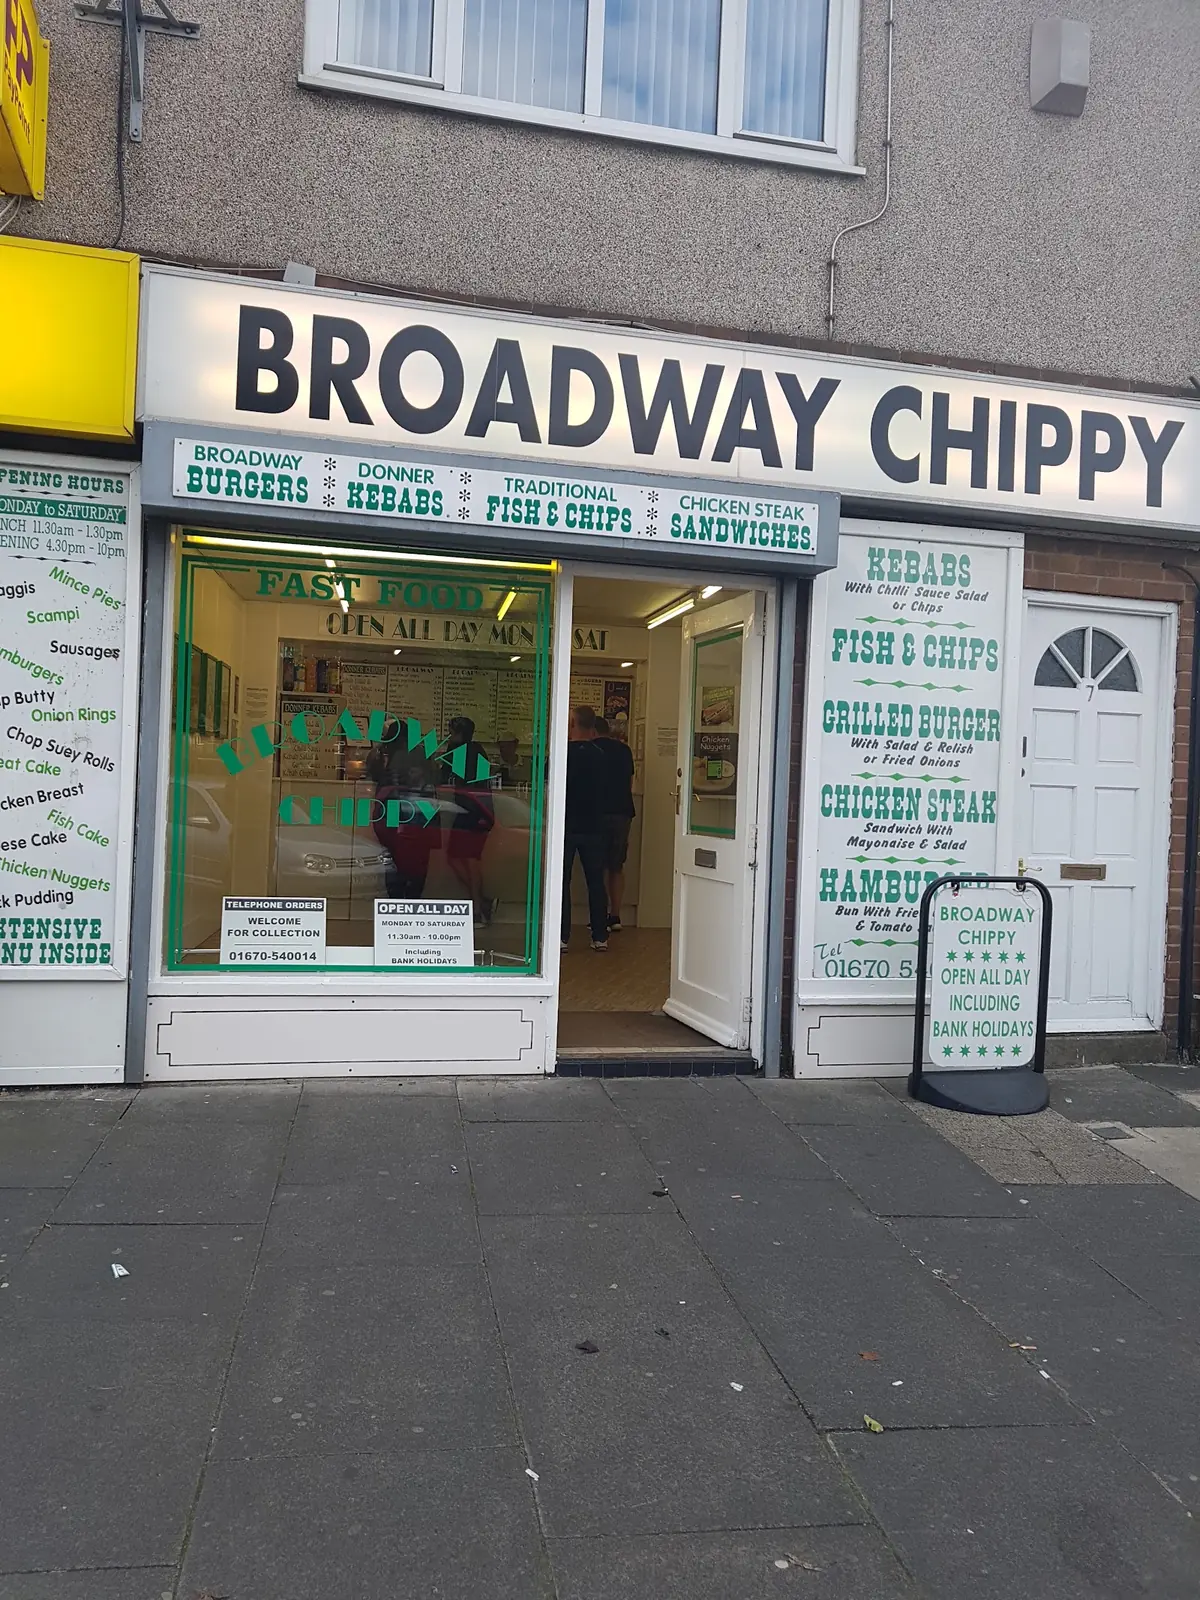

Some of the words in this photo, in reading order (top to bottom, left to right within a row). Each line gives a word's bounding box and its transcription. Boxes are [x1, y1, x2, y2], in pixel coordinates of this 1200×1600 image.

[235, 304, 842, 473] BROADWAY
[870, 384, 1186, 508] CHIPPY
[194, 444, 303, 471] BROADWAY
[358, 462, 435, 485] DONNER
[67, 475, 124, 494] HOURS
[186, 464, 309, 503] BURGERS
[504, 477, 618, 503] TRADITIONAL
[346, 481, 444, 516] KEBABS
[44, 503, 55, 516] to
[58, 503, 123, 523] SATURDAY
[486, 495, 541, 526] FISH
[546, 501, 559, 526] &
[565, 503, 633, 533] CHIPS
[679, 495, 750, 515] CHICKEN
[754, 504, 805, 522] STEAK
[33, 519, 75, 537] 11.30am
[86, 524, 124, 542] 1.30pm
[671, 513, 811, 551] SANDWICHES
[46, 538, 86, 556] 4.30pm
[97, 543, 126, 558] 10pm
[867, 546, 971, 588] KEBABS
[49, 566, 91, 595] Mince
[92, 588, 122, 611] Pies
[256, 569, 361, 603] FAST
[376, 579, 484, 612] FOOD
[844, 581, 873, 596] With
[877, 583, 910, 598] Chilli
[914, 586, 951, 600] Sauce
[954, 589, 989, 602] Salad
[26, 606, 81, 624] Scampi
[892, 602, 907, 611] or
[910, 601, 944, 615] Chips
[326, 611, 386, 639] OPEN
[391, 616, 436, 642] ALL
[443, 620, 485, 645] DAY
[488, 623, 535, 648] MON
[571, 628, 610, 651] SAT
[50, 640, 121, 661] Sausages
[832, 628, 895, 666] FISH
[901, 632, 917, 667] &
[922, 634, 999, 672] CHIPS
[14, 690, 56, 706] Butty
[1085, 684, 1095, 702] 7
[31, 708, 74, 723] Onion
[78, 708, 117, 724] Rings
[822, 700, 914, 738] GRILLED
[918, 704, 1000, 742] BURGER
[6, 726, 43, 750] Chop
[45, 739, 81, 763] Suey
[83, 753, 116, 772] Rolls
[215, 707, 502, 784] BROADWAY
[700, 743, 731, 752] Nuggets
[850, 737, 879, 750] With
[883, 739, 919, 752] Salad
[923, 742, 933, 752] &
[937, 742, 974, 755] Relish
[25, 759, 62, 777] Cake
[863, 756, 879, 766] or
[882, 754, 914, 767] Fried
[919, 755, 961, 768] Onions
[37, 782, 85, 803] Breast
[278, 795, 442, 829] CHIPPY
[820, 784, 922, 821] CHICKEN
[927, 789, 997, 824] STEAK
[47, 808, 74, 831] Fish
[76, 826, 111, 848] Cake
[863, 822, 923, 836] Sandwich
[926, 824, 953, 836] With
[31, 830, 68, 847] Cake
[846, 836, 915, 852] Mayonaise
[919, 840, 930, 850] &
[933, 839, 968, 851] Salad
[0, 857, 48, 880] hicken
[50, 868, 111, 893] Nuggets
[15, 889, 74, 907] Pudding
[226, 900, 283, 909] TELEPHONE
[285, 901, 323, 911] ORDERS
[378, 904, 413, 914] OPEN
[416, 904, 442, 915] ALL
[444, 905, 469, 915] DAY
[834, 906, 860, 917] Bun
[863, 906, 892, 918] With
[895, 907, 920, 919] Frie
[940, 906, 1035, 923] BROADWAY
[248, 916, 302, 926] WELCOME
[381, 920, 412, 928] MONDAY
[427, 920, 466, 928] SATURDAY
[855, 921, 866, 932] &
[869, 921, 914, 933] Tomato
[227, 928, 248, 938] FOR
[252, 928, 321, 938] COLLECTION
[387, 933, 421, 941] 11.30am
[428, 933, 462, 942] 10.00pm
[958, 930, 1016, 945] CHIPPY
[39, 942, 112, 965] INSIDE
[229, 950, 317, 962] 01670-540014
[405, 948, 442, 957] Including
[814, 943, 843, 960] Tel
[391, 957, 415, 965] BANK
[417, 957, 458, 966] HOLIDAYS
[825, 959, 891, 979] 01670
[941, 968, 976, 985] OPEN
[979, 969, 1001, 985] ALL
[1004, 969, 1031, 985] DAY
[949, 995, 1020, 1011] INCLUDING
[933, 1021, 968, 1037] BANK
[972, 1021, 1034, 1037] HOLIDAYS
